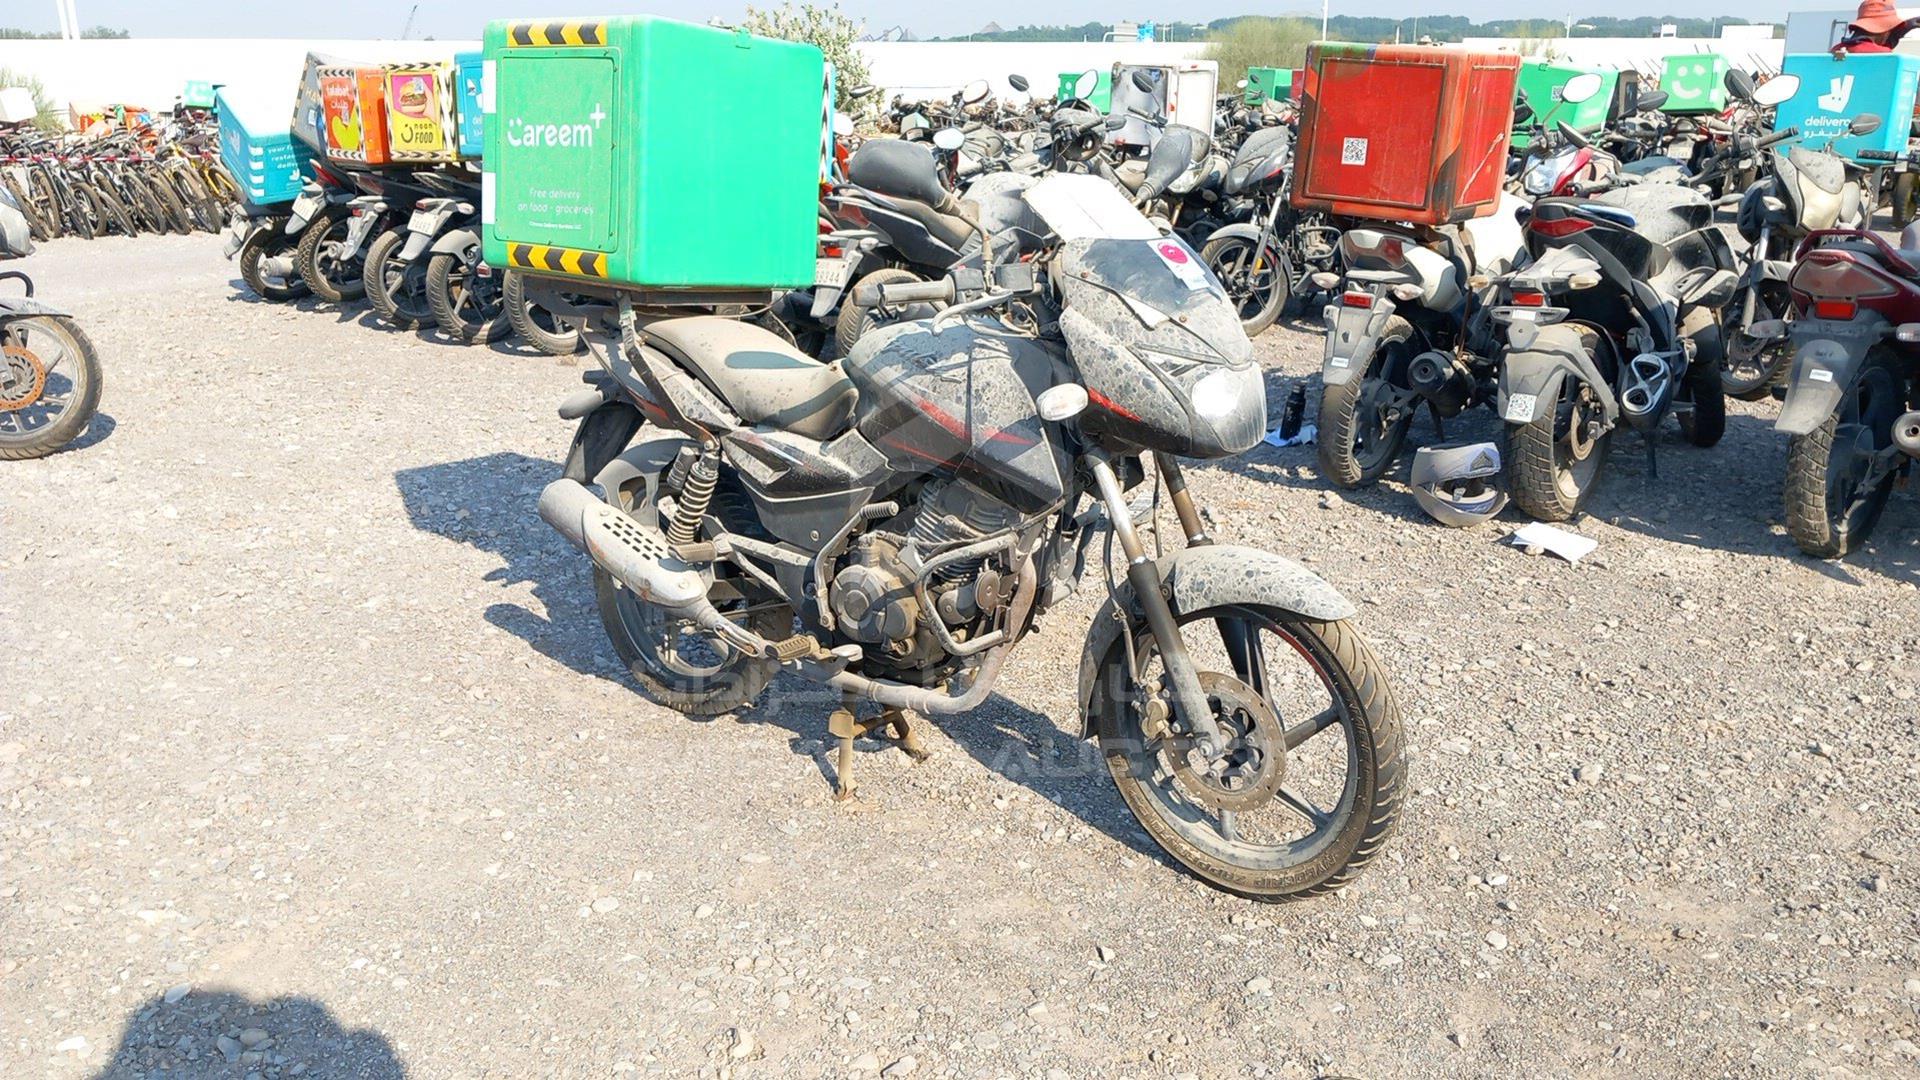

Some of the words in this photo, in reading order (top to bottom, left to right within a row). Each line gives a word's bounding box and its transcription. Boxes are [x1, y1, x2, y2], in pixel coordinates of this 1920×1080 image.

[1804, 115, 1852, 127] delivero
[414, 131, 434, 144] FOOD
[548, 189, 581, 200] delivery
[555, 204, 594, 216] groceries
